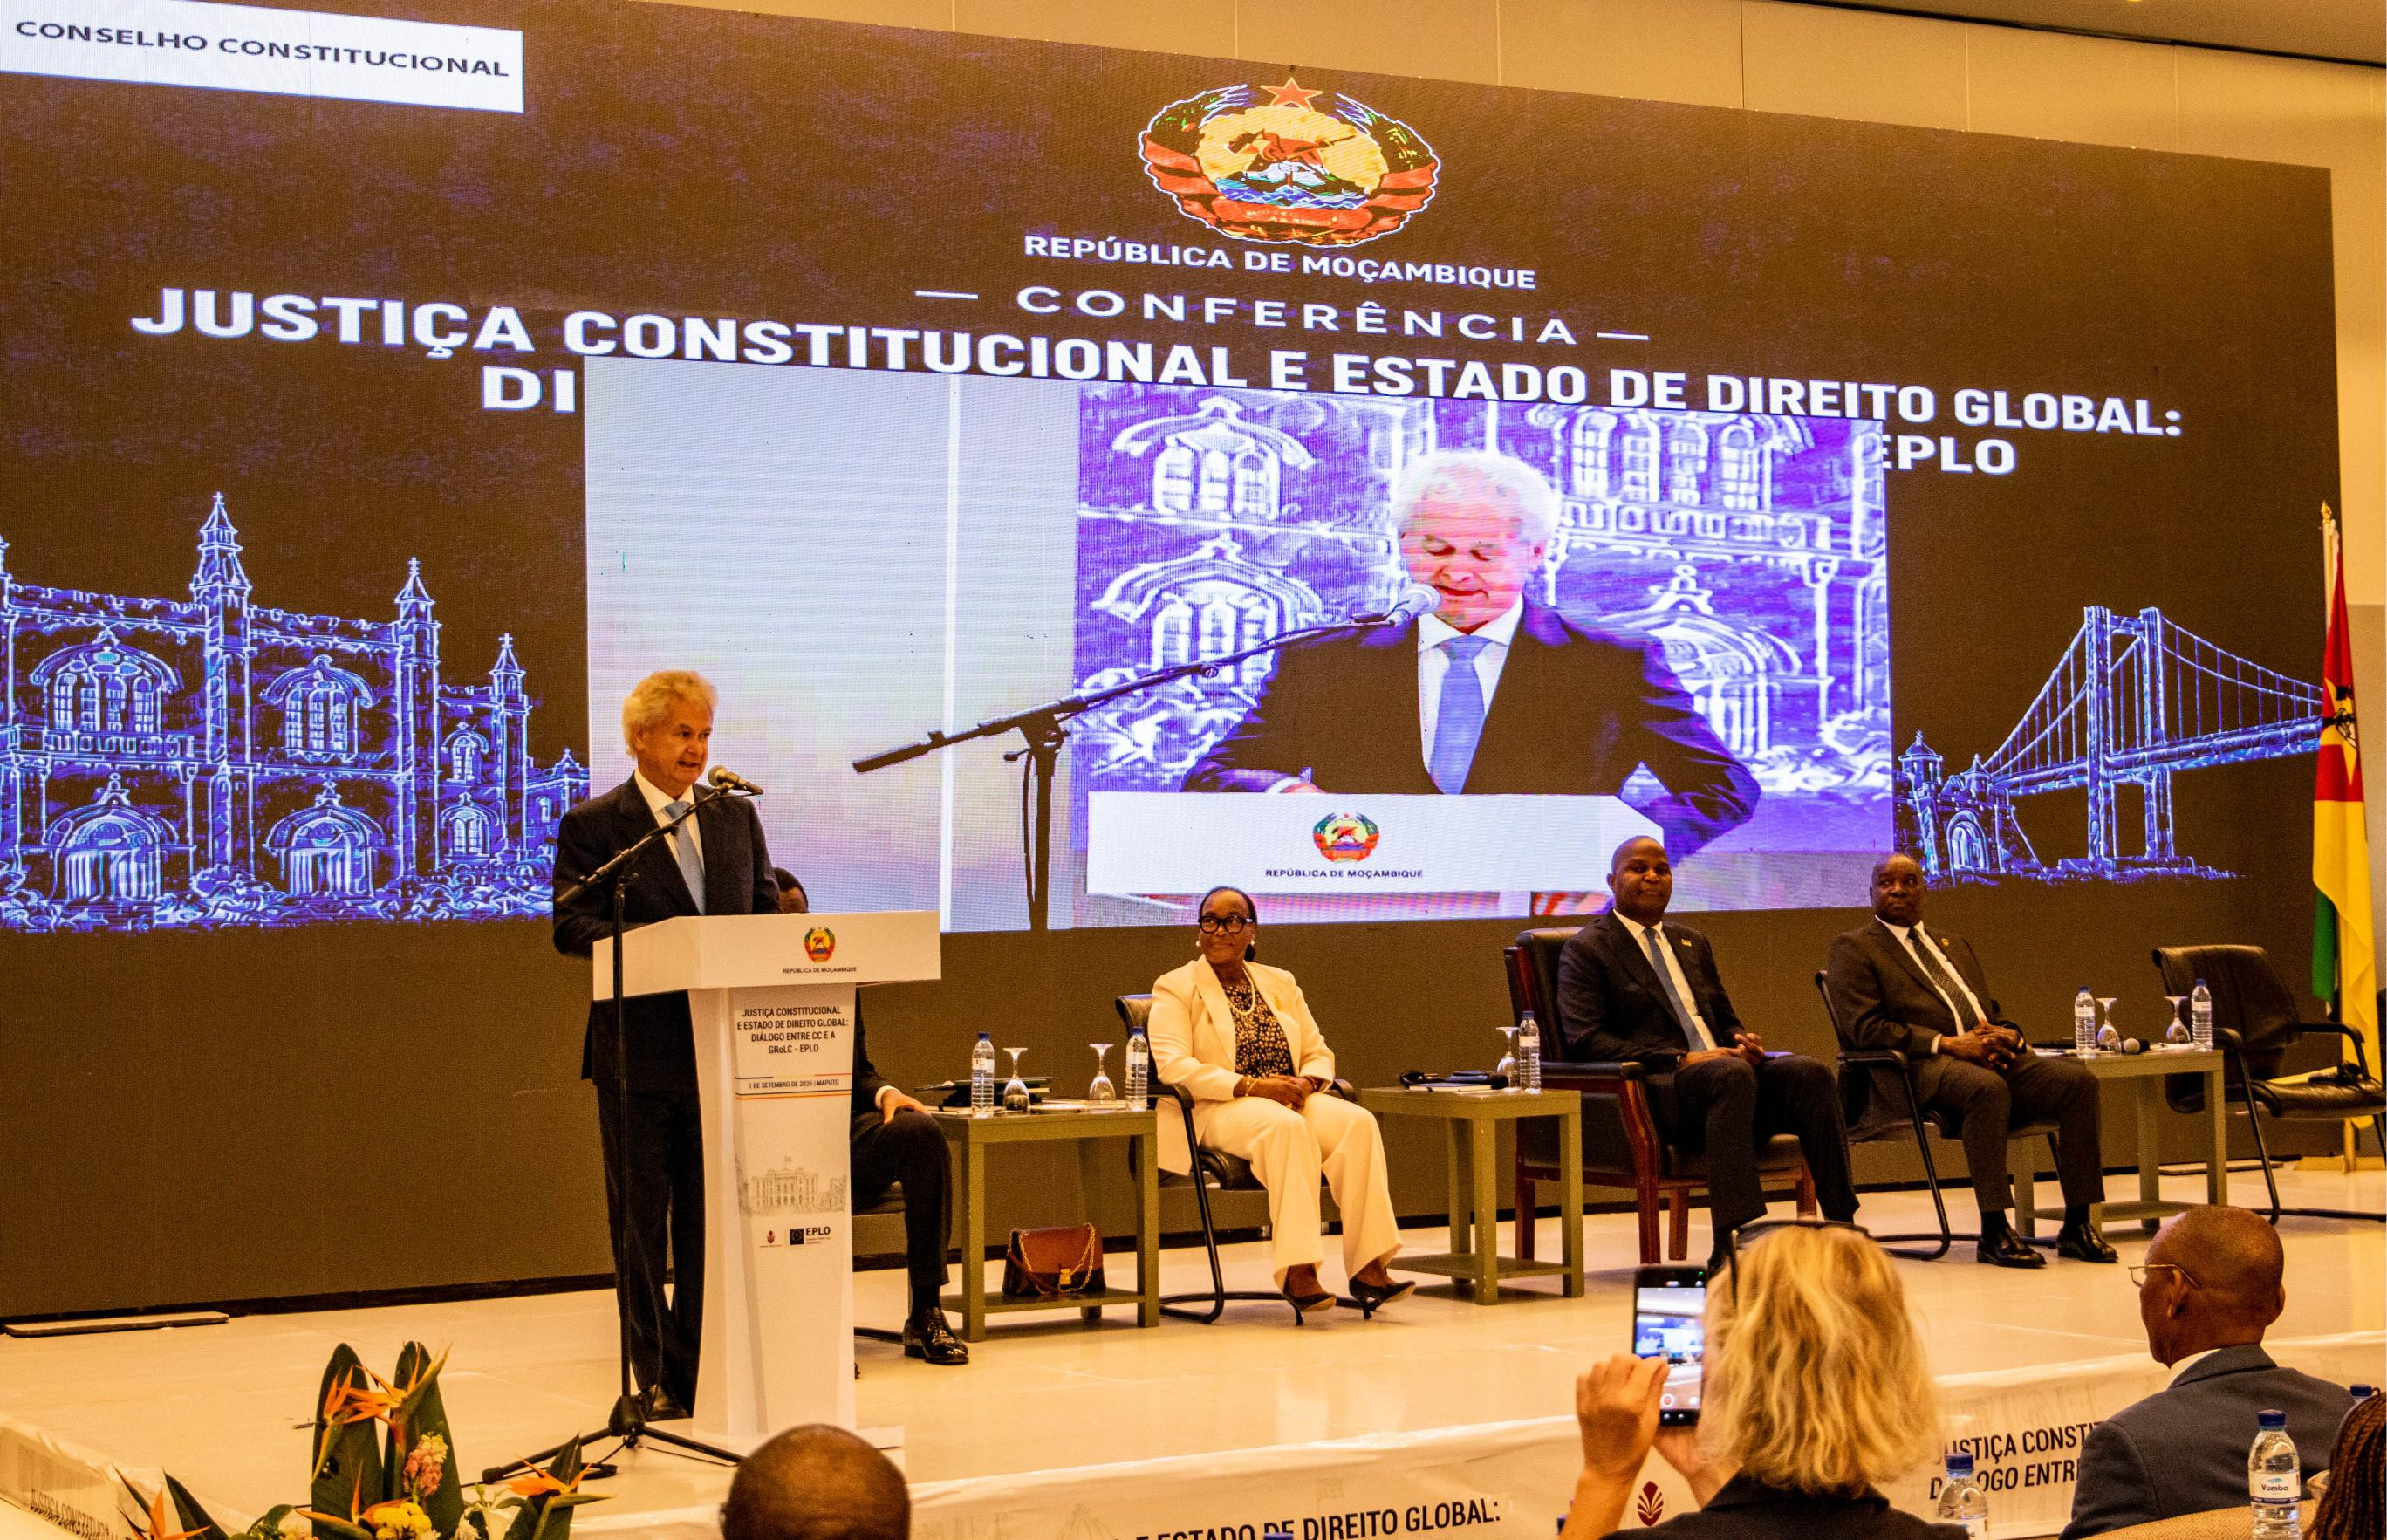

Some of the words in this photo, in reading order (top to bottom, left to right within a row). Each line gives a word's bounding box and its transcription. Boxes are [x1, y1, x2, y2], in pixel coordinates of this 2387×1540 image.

[17, 21, 208, 51] CONSELHO
[219, 38, 510, 77] CONSTITUCIONAL
[1024, 236, 1232, 269] REPÚBLICA
[1244, 250, 1291, 273] DE
[1302, 255, 1536, 290] MOÇAMBIQUE
[1016, 285, 1577, 345] CONFERÊNCIA
[131, 287, 535, 359] JUSTIÇA
[564, 311, 1248, 387] CONSTITUCIONAL
[1270, 350, 1308, 390] E
[1332, 353, 1588, 405] ESTADO
[1611, 368, 1686, 410] DE
[1706, 374, 1935, 422] DIREITO
[1953, 388, 2181, 436] GLOBAL:
[1265, 868, 1327, 878] REPÚBLICA
[1348, 869, 1424, 880] MOÇAMBIQUE
[737, 1022, 742, 1030] E
[743, 1020, 773, 1030] ESTADO
[775, 1020, 784, 1029] DE
[787, 1019, 816, 1028] DIREITO
[817, 1018, 849, 1028] GLOBAL:
[742, 1008, 775, 1019] JUSTIÇA
[776, 1006, 841, 1016] CONSTITUCIONAL
[751, 1031, 784, 1042] DIÁLOGO
[786, 1031, 810, 1041] ENTRE
[812, 1030, 823, 1039] CC
[830, 1030, 836, 1039] A
[769, 1045, 793, 1054] GRoLC
[799, 1044, 819, 1053] EPLO
[805, 1226, 831, 1236] EPLO
[1929, 1466, 2019, 1500] DOGO
[1303, 1509, 1398, 1540] DIREITO
[1405, 1498, 1501, 1532] GLOBAL:
